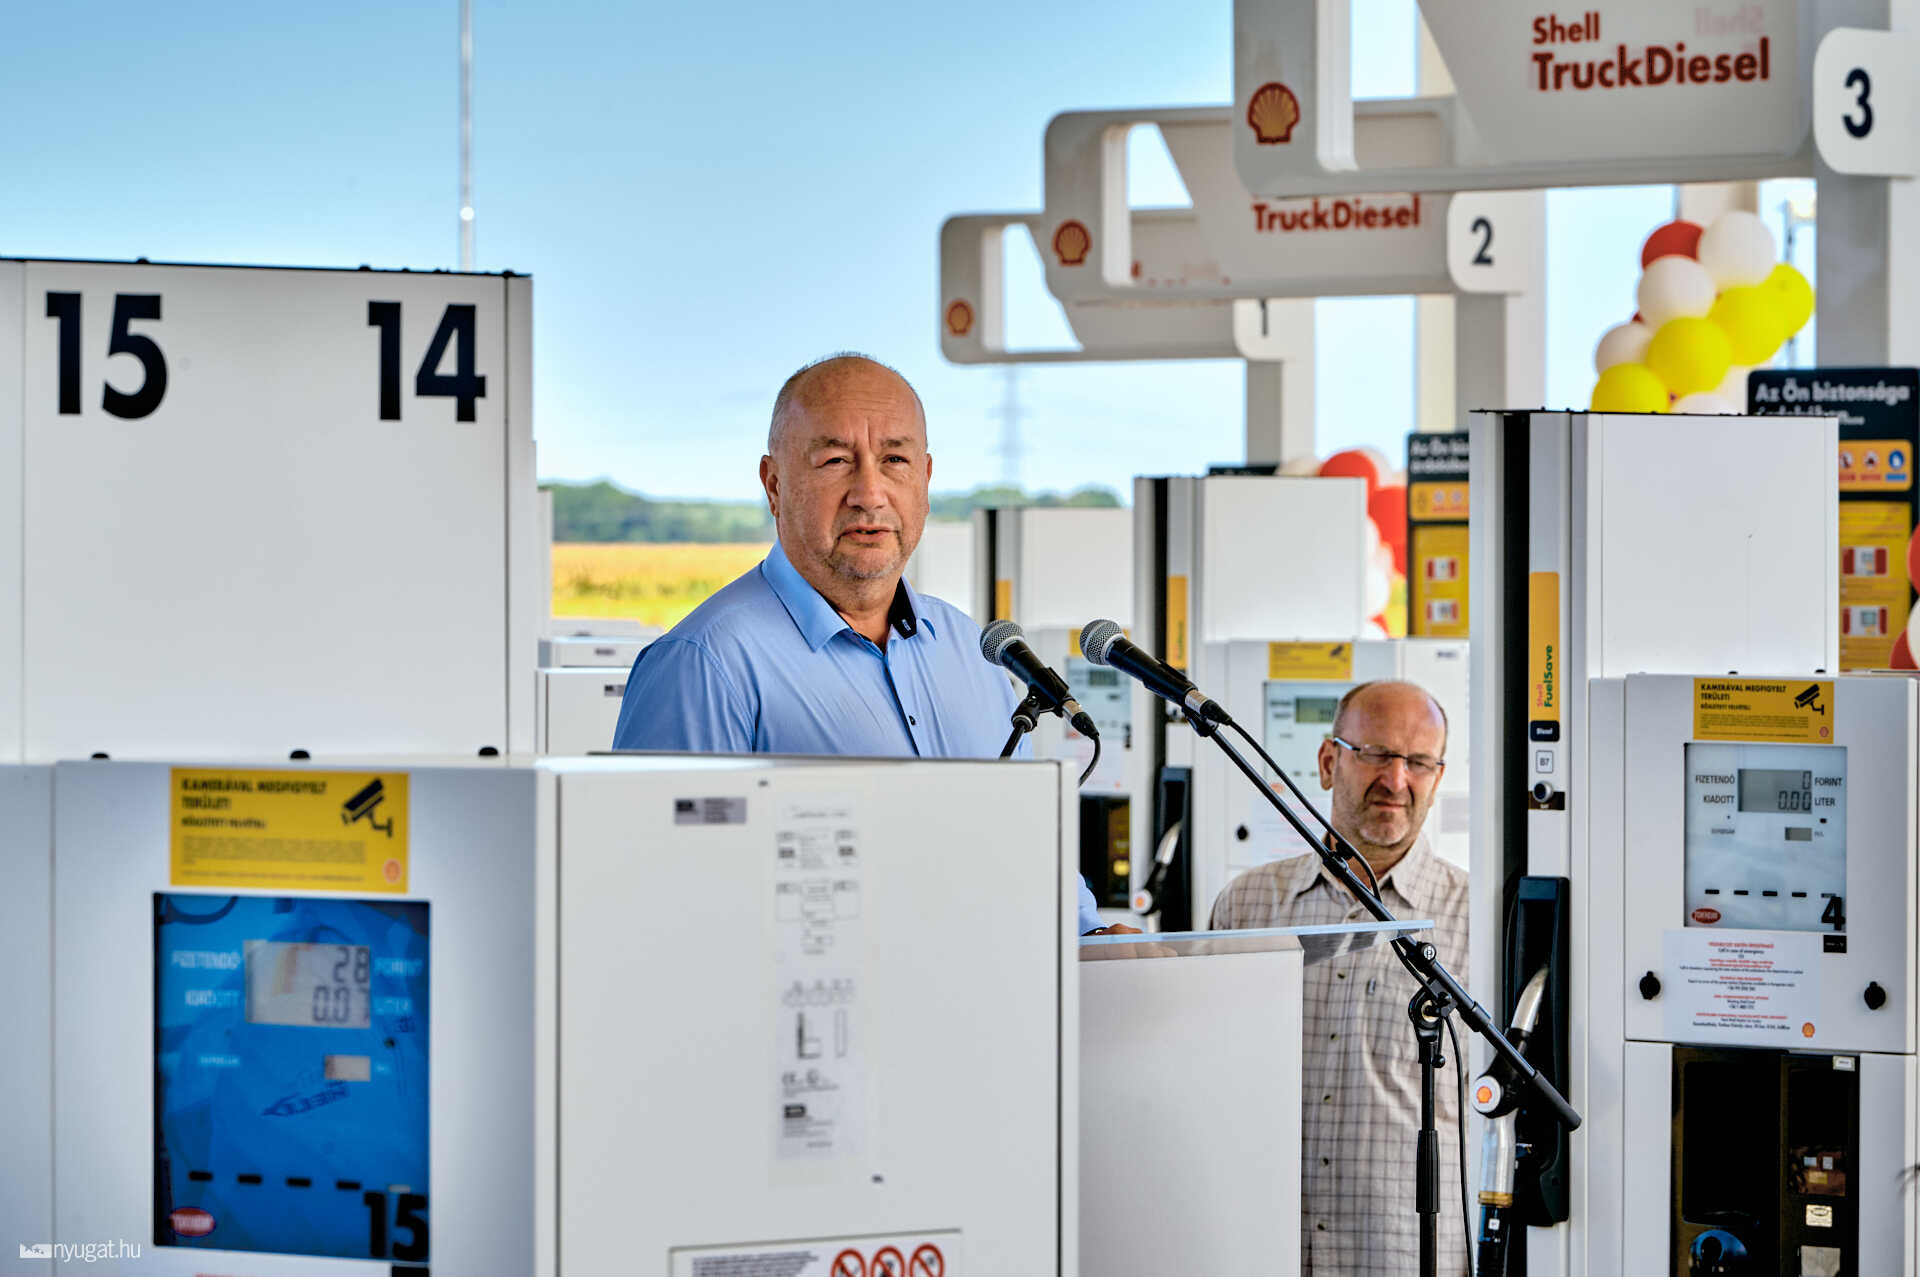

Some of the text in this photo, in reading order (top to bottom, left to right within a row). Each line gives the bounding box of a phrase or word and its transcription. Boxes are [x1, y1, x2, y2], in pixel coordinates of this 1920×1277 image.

[1532, 12, 1600, 44] Shell
[1532, 37, 1770, 91] TruckDiesel
[1842, 68, 1874, 138] 3
[1252, 194, 1421, 232] TruckDiesel
[1470, 217, 1495, 265] 2
[46, 291, 169, 420] 15
[368, 301, 487, 423] 14
[1755, 378, 1911, 406] Az Ön biztonsága
[1544, 645, 1553, 708] FuelSave
[1701, 682, 1787, 693] KAMERÁVAL MEGFIGYELT
[1814, 777, 1842, 786] FORINT
[1703, 795, 1735, 804] KIADOTT
[1815, 797, 1836, 807] LITER
[1821, 896, 1846, 931] 4
[333, 947, 370, 984] 28
[364, 1191, 429, 1262] 15
